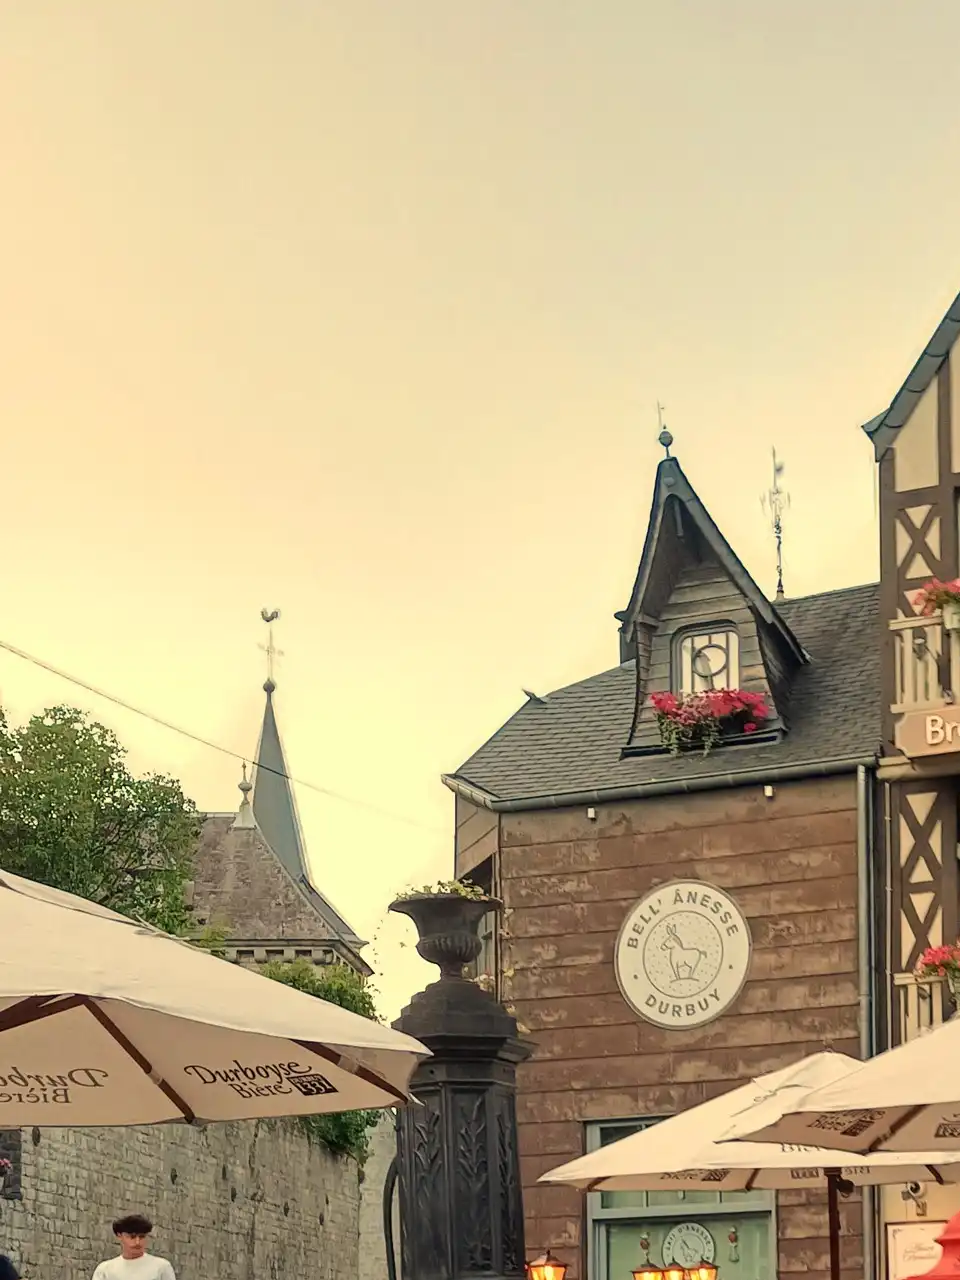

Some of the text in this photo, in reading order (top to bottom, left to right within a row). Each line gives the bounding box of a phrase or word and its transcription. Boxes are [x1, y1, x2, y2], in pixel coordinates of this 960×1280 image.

[627, 889, 739, 949] BELL' ÂNESSE
[645, 988, 720, 1017] DURBUY
[183, 1060, 312, 1084] Durboyse
[228, 1082, 293, 1099] Bière
